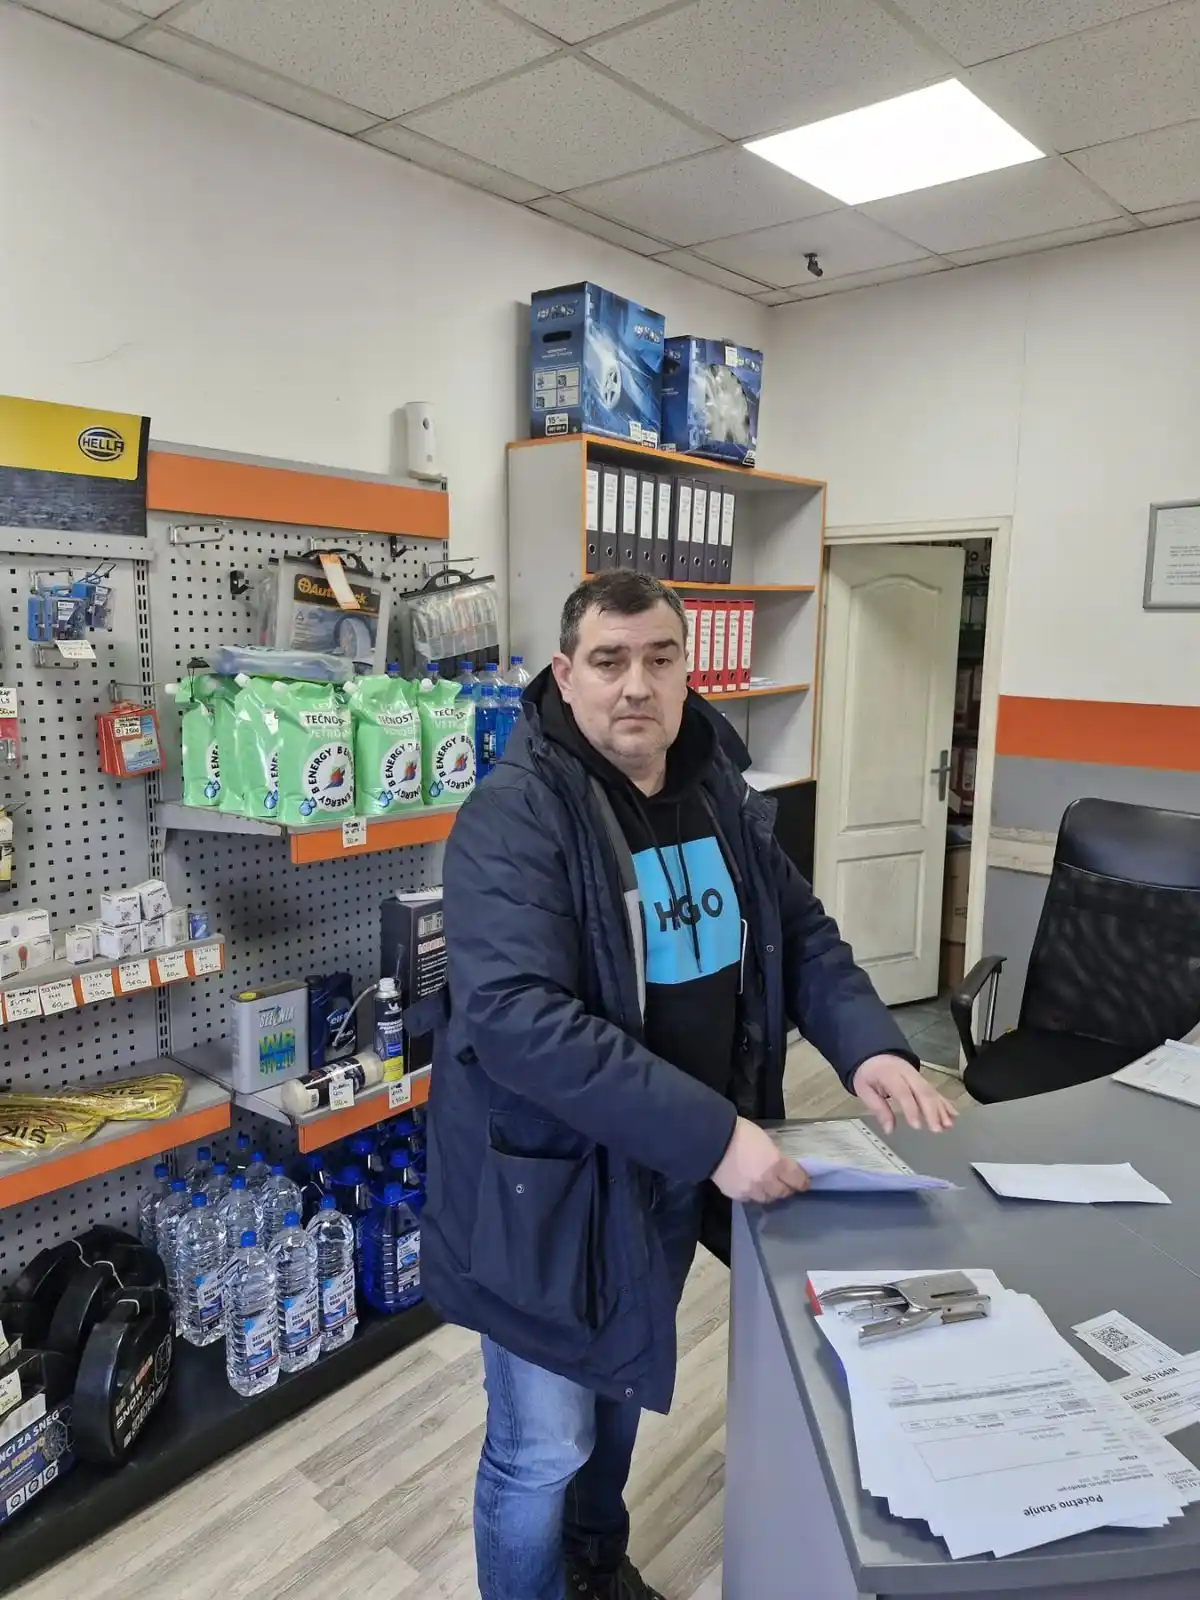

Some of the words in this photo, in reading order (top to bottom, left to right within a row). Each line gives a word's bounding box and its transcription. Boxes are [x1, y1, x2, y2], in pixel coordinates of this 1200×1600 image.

[82, 437, 124, 453] HELLA
[308, 748, 332, 785] ENERGY
[385, 744, 406, 779] ENERGY
[436, 737, 457, 770] ENERGY
[116, 1385, 143, 1429] SNOW
[17, 1433, 32, 1449] ZA
[33, 1409, 60, 1437] SNEG
[1023, 1504, 1057, 1517] stanje
[1059, 1494, 1104, 1510] Početno
